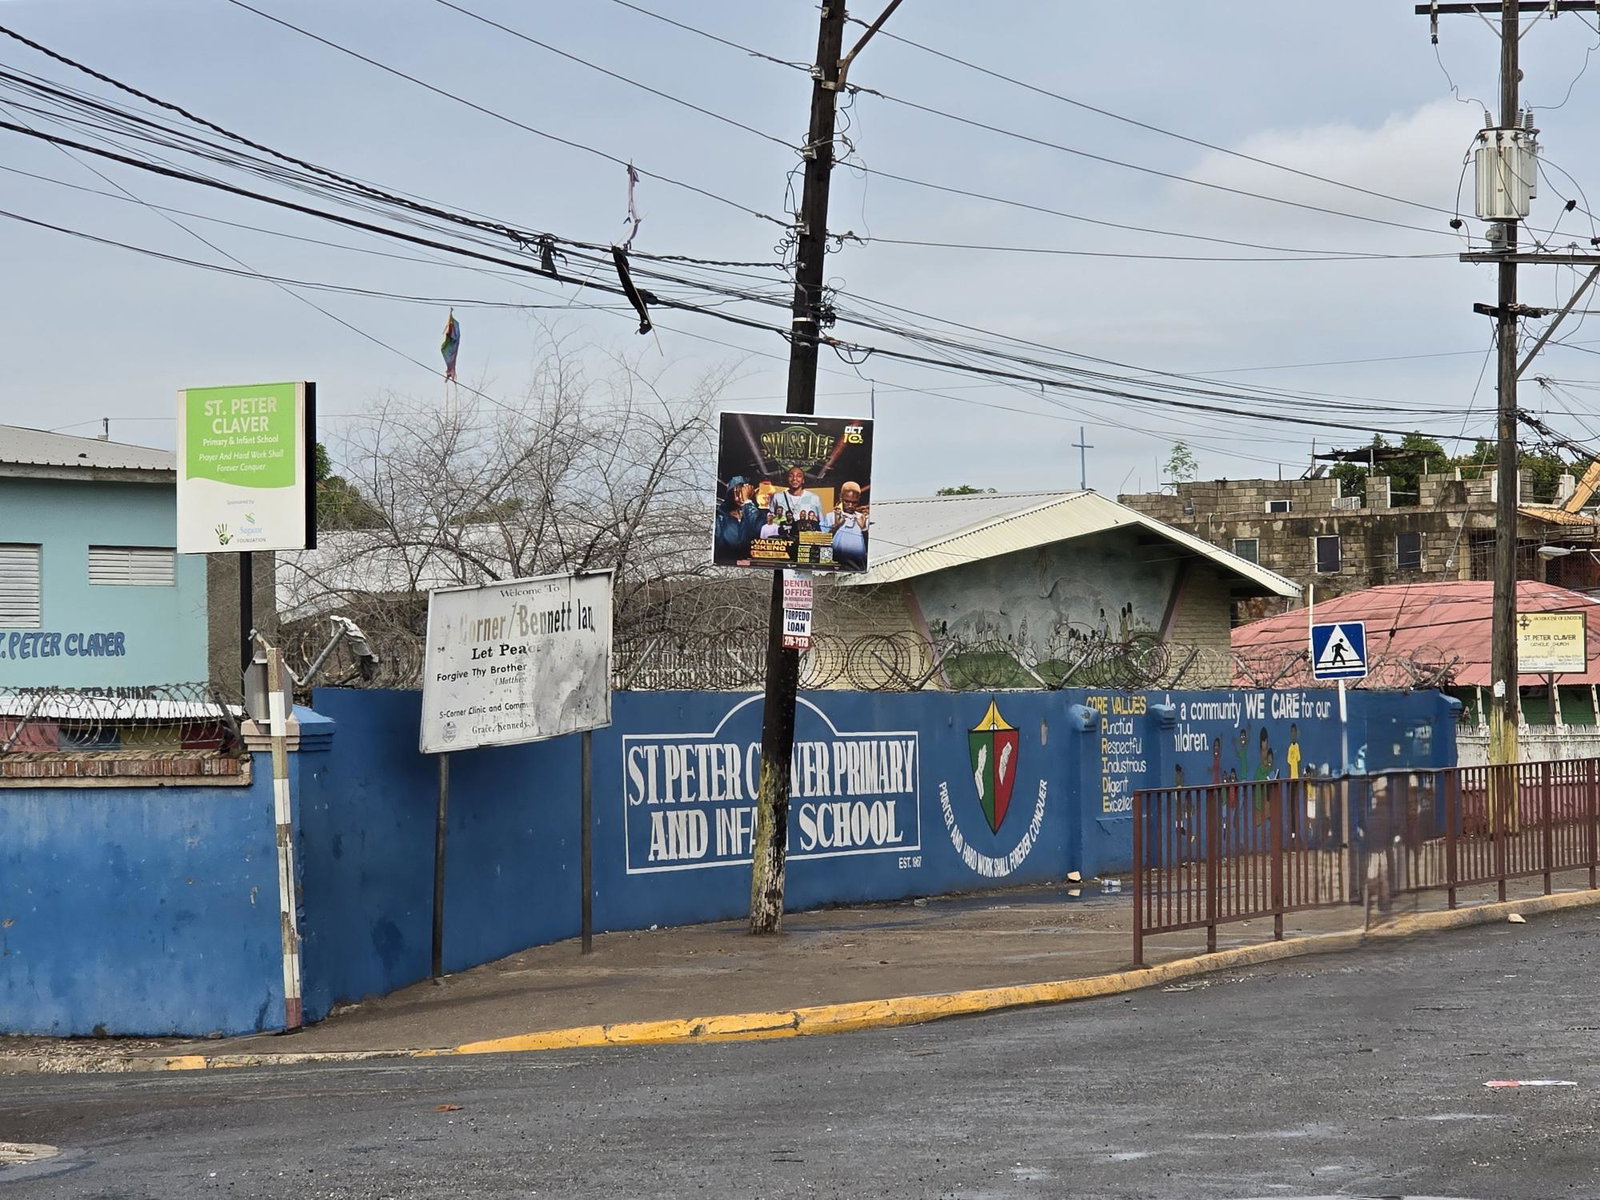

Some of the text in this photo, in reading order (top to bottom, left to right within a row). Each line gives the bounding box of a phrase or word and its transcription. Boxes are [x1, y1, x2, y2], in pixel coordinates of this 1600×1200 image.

[204, 397, 277, 416] ST. PETER
[212, 416, 269, 434] CLAVER
[844, 426, 864, 434] OCT
[202, 434, 279, 447] Primary & Infant School
[760, 431, 807, 459] SWISS
[199, 449, 285, 462] Prayer And Hard Work Shall
[216, 463, 266, 472] Forever Conquer
[754, 539, 794, 547] VALIANT
[500, 583, 561, 598] Welcome To
[784, 580, 813, 588] DENTAL
[785, 588, 812, 597] OFFICE
[785, 610, 811, 622] TORPEDO
[787, 622, 806, 633] LOAN
[9, 631, 62, 660] PETER
[65, 631, 126, 657] CLAVER
[471, 646, 493, 660] Let
[436, 663, 528, 683] Forgive Thy Brother
[439, 709, 467, 720] S-Corner
[468, 706, 487, 715] Clinic
[488, 703, 502, 713] and
[1085, 696, 1107, 715] CORE
[1180, 702, 1187, 721] a
[1190, 693, 1242, 728] community
[1245, 693, 1265, 719] WE
[1271, 692, 1300, 719] CARE
[1301, 692, 1314, 719] for
[1315, 700, 1332, 720] our
[1101, 717, 1134, 736] Punctual
[1101, 737, 1142, 757] Respectful
[663, 742, 743, 803] PETER
[745, 741, 831, 800] CVER
[832, 739, 915, 797] PRIMARY
[1101, 756, 1147, 774] Industrious
[648, 808, 709, 862] AND
[799, 800, 904, 851] SCHOOL
[938, 781, 955, 830] PRAYER
[950, 824, 964, 854] AND
[961, 842, 978, 871] HARD
[977, 852, 994, 878] WORK
[993, 855, 1010, 878] SHALL
[1029, 779, 1048, 843] CONQUER
